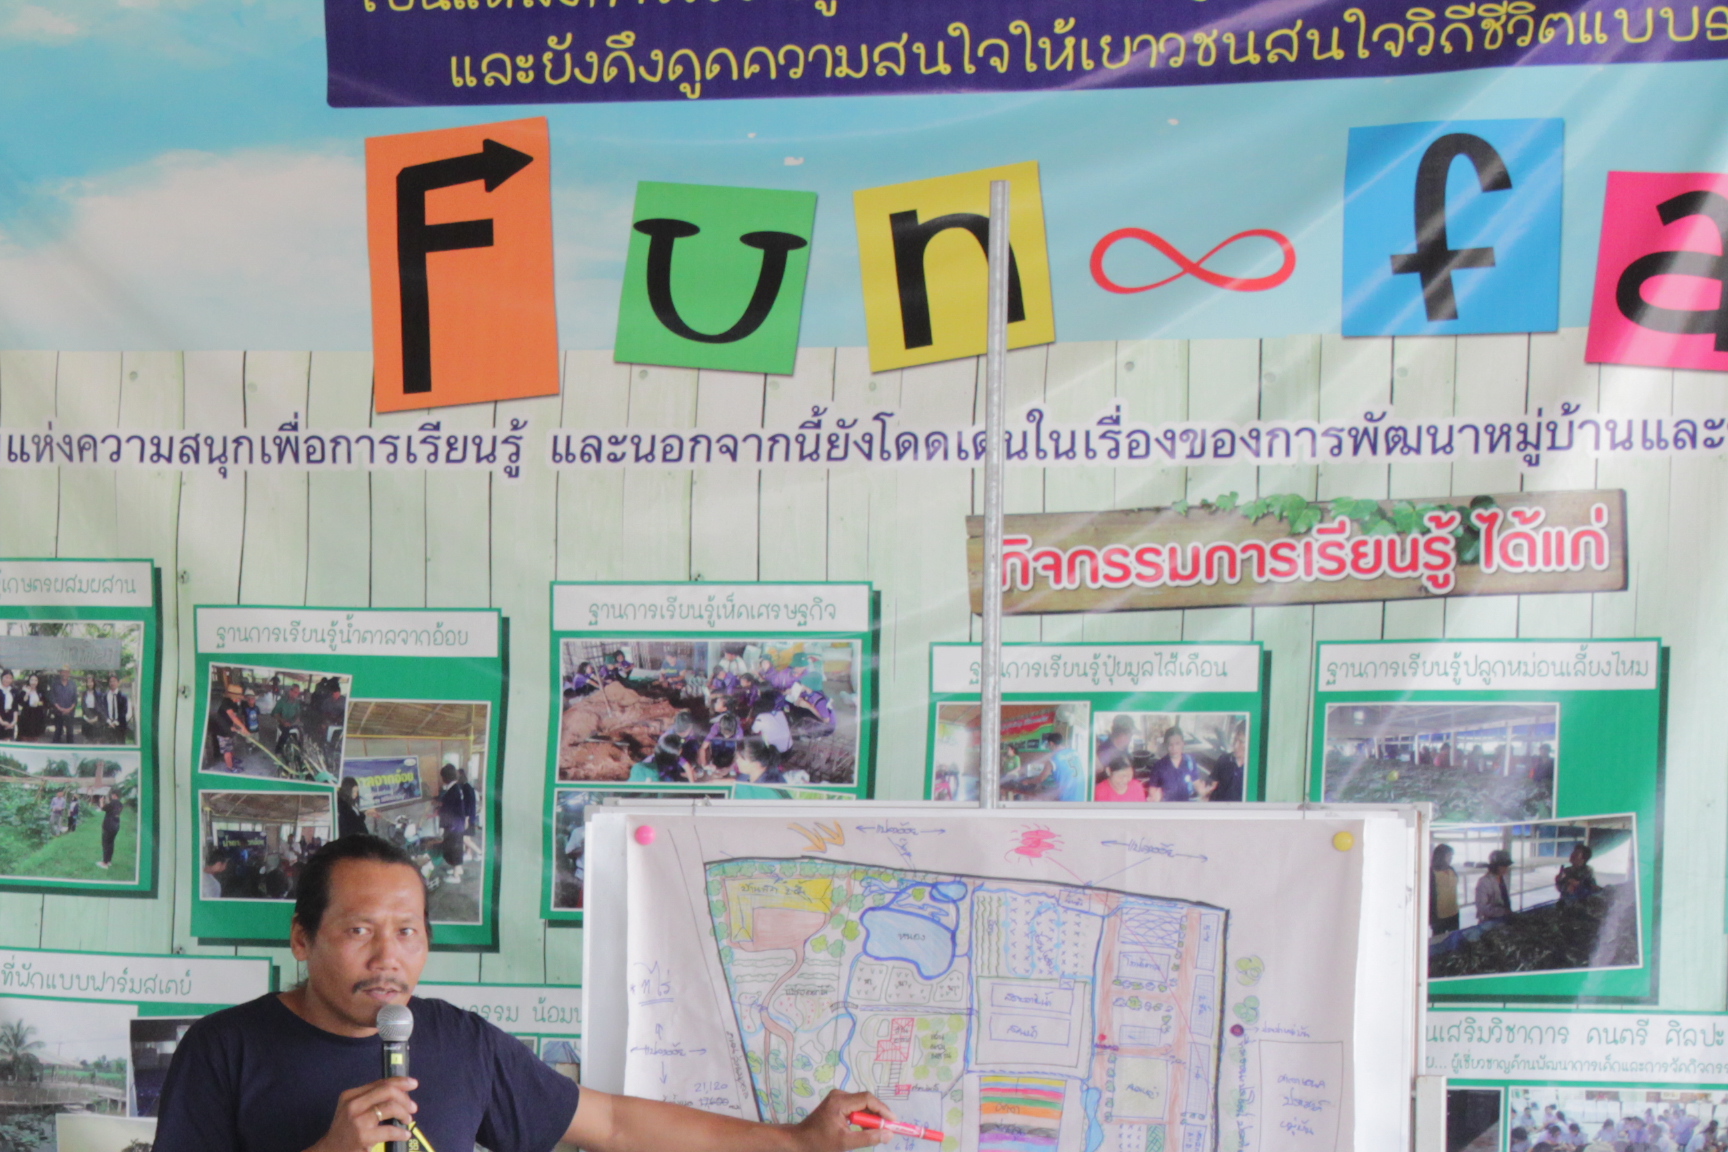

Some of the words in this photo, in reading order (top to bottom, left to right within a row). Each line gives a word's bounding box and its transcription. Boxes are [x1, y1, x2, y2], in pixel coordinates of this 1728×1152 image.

[550, 402, 1726, 469] และนอกจากนี้ยังโดดเดนในเรื่องของการพัฒนาหมู่บ้านและ
[1475, 503, 1609, 573] ได้แก่
[588, 592, 837, 628] ฐานการเรียนรู้เห็ดเศรษฐกิจ
[215, 613, 469, 651] ฐานการเรียนรู้น้ำตาลจากอ้อย
[968, 651, 1228, 686] ฐการเรียนรู้ปุ๋ยมูลไส้เดือน
[1325, 644, 1649, 685] ฐานการเรียนรู้ปลูกหม่อนเลี้ยงไหม
[1665, 1019, 1725, 1048] ศิลปะ
